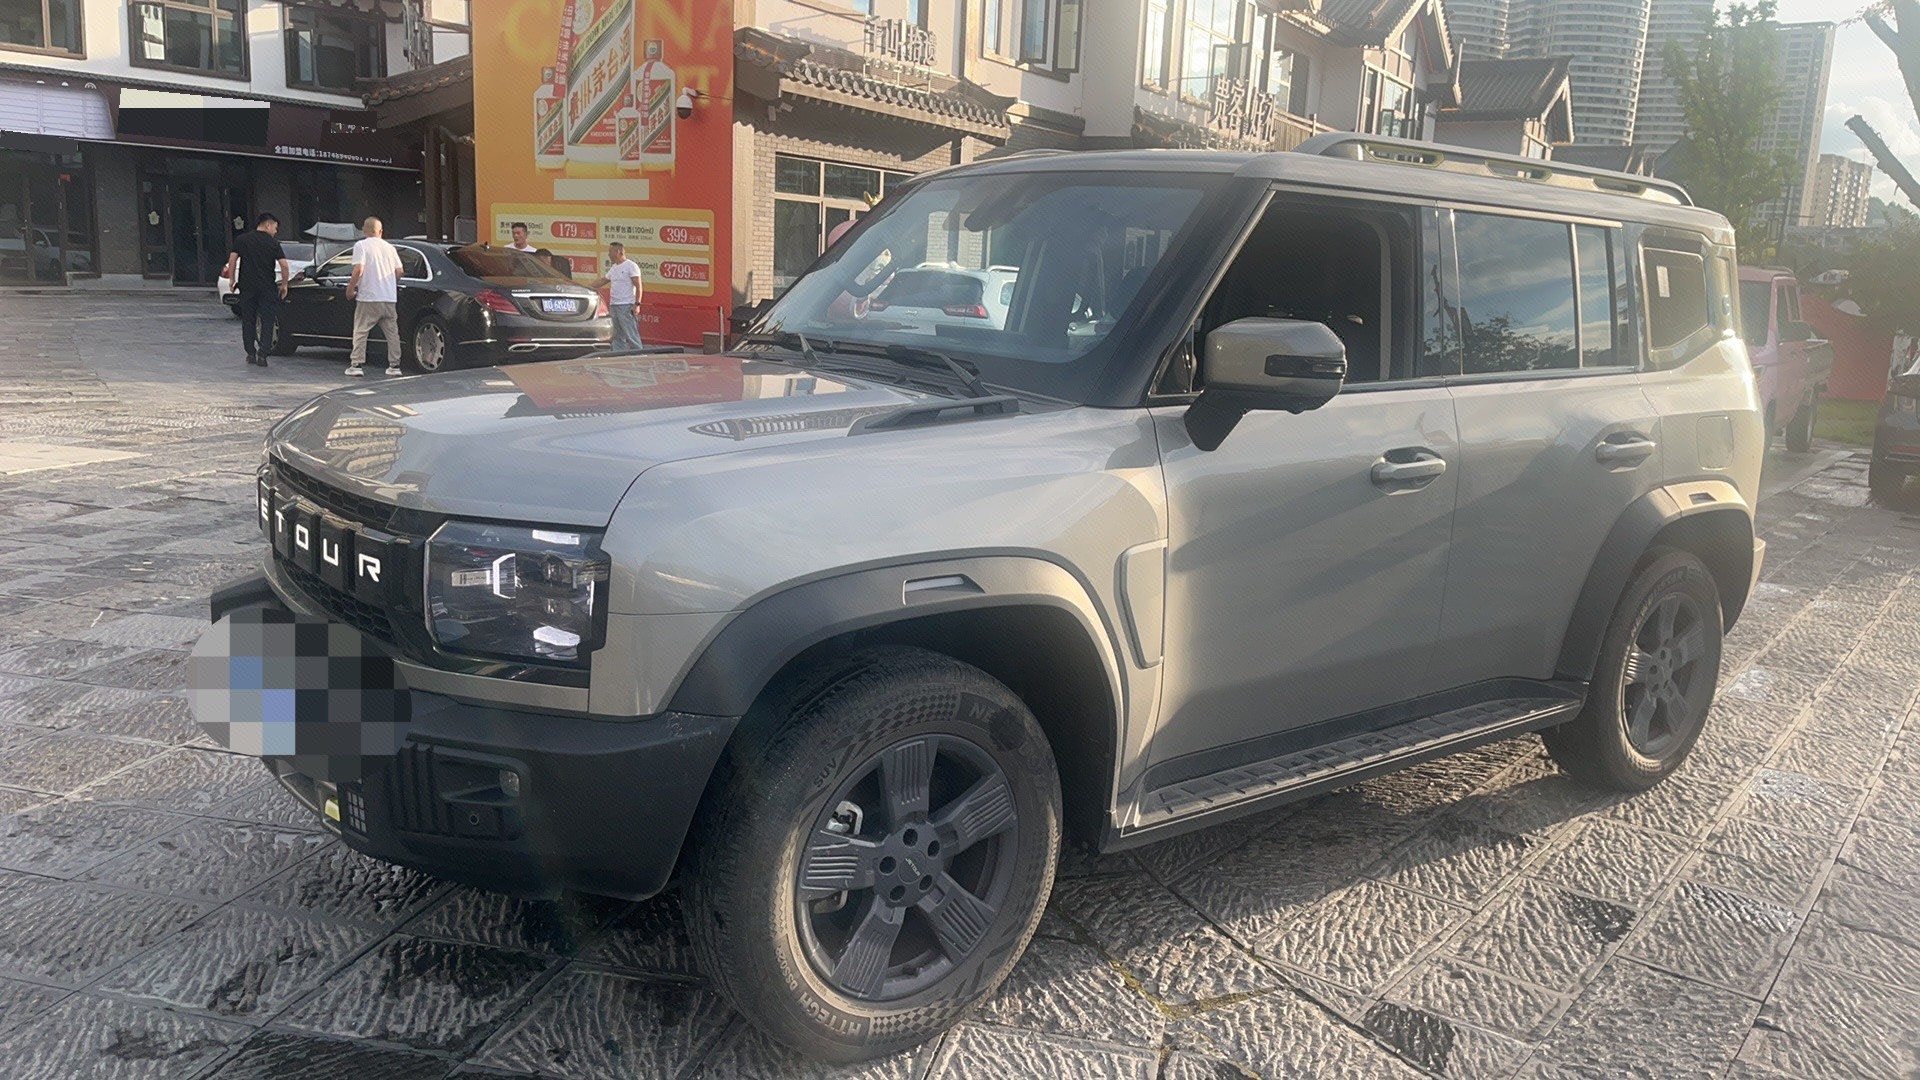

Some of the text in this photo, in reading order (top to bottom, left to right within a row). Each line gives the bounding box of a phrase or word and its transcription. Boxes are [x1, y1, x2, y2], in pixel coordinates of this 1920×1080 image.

[559, 222, 578, 238] 179
[666, 227, 689, 243] 399
[663, 263, 692, 279] 3799
[261, 497, 381, 583] ETOUR
[813, 757, 837, 788] SUV
